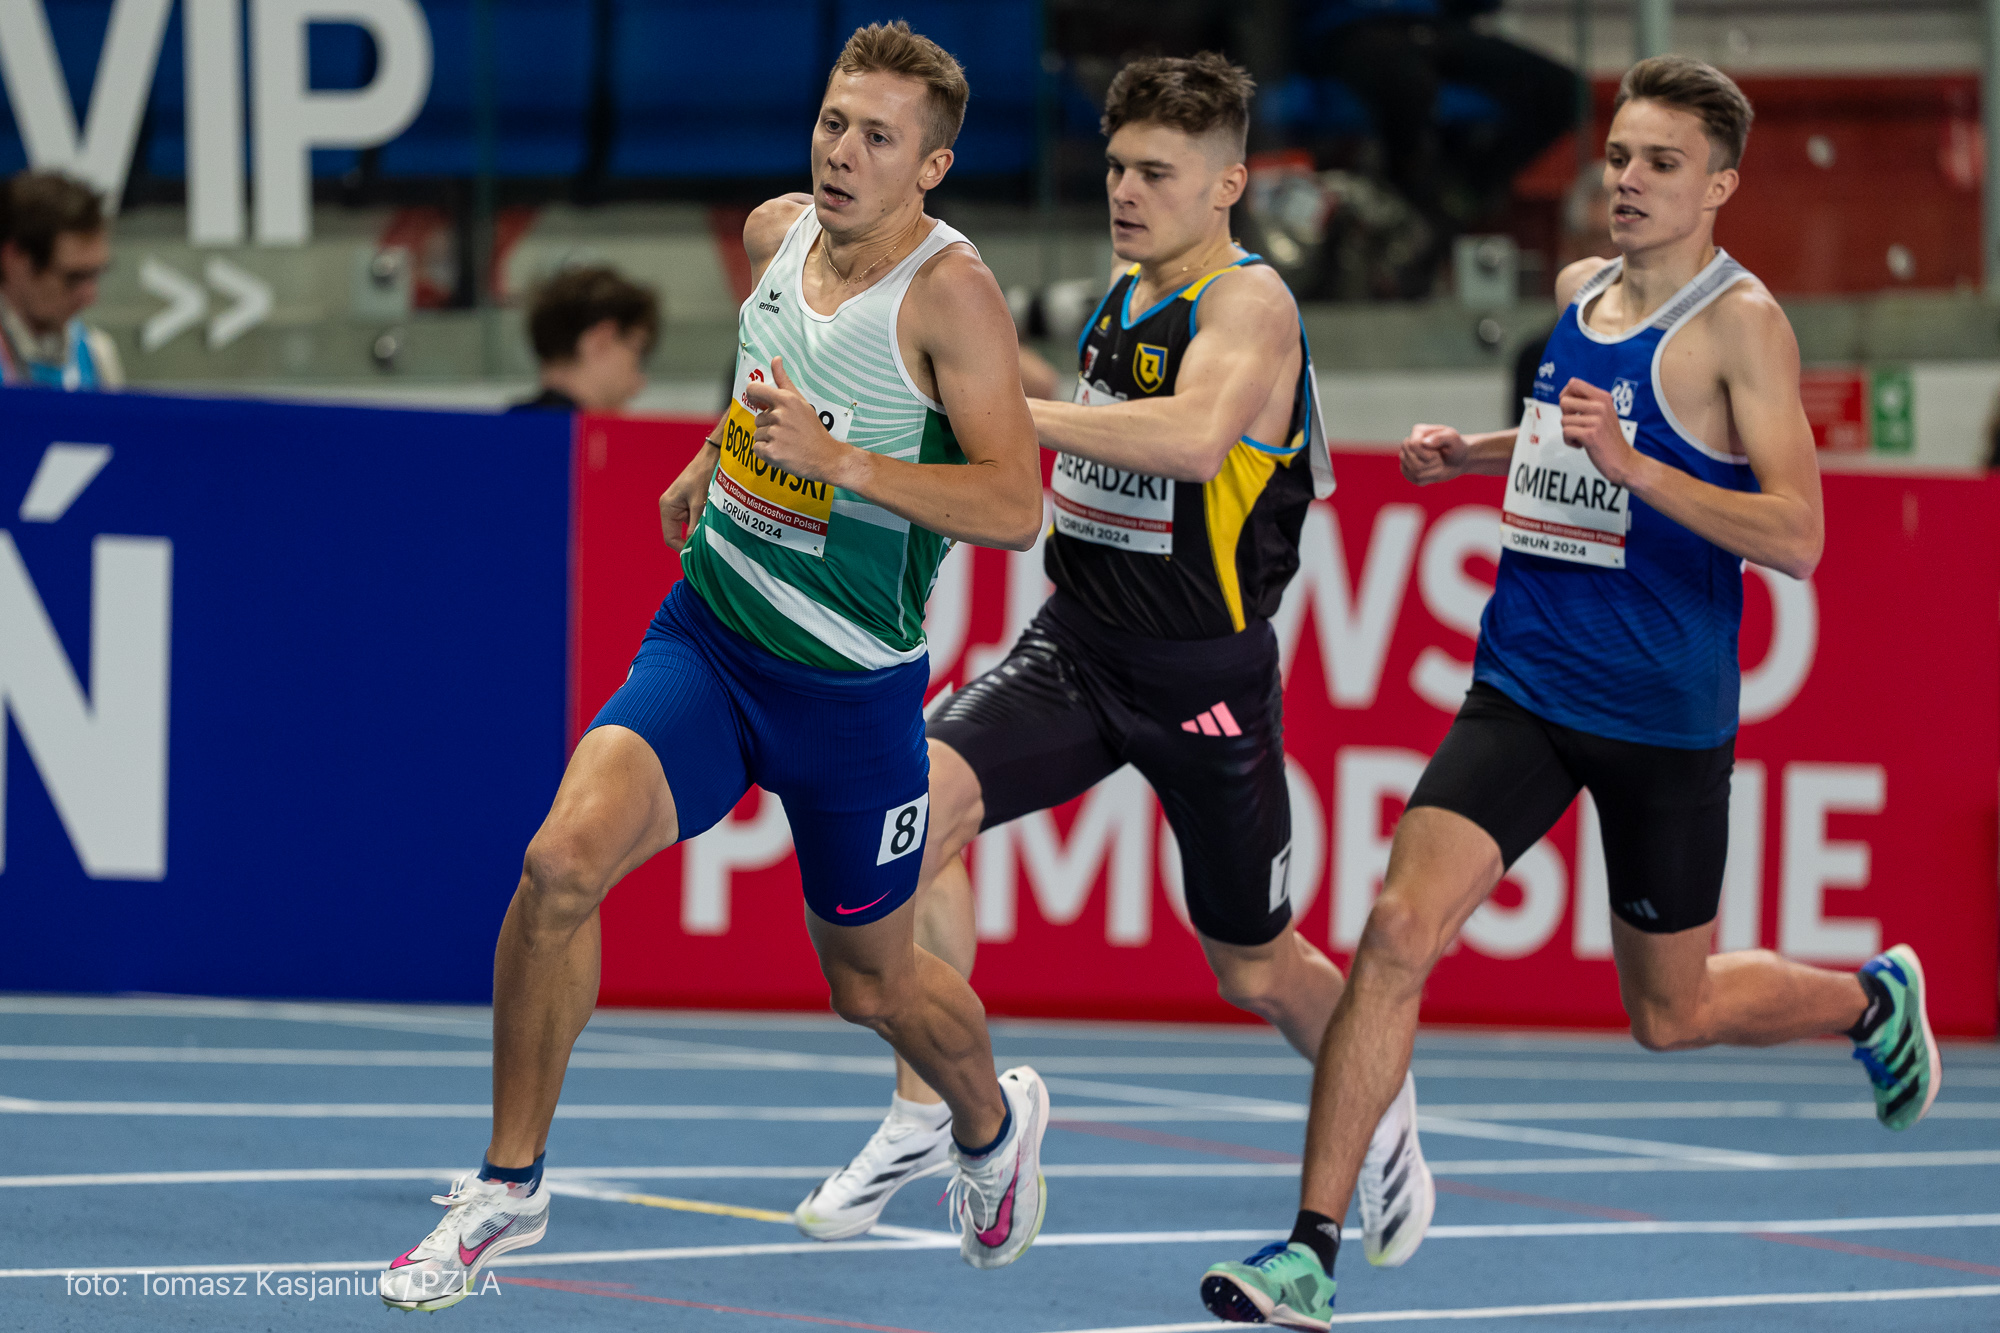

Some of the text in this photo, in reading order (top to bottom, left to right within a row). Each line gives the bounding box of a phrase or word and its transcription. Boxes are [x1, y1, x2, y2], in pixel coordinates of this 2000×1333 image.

[0, 0, 435, 247] VIP
[759, 302, 780, 314] erima
[723, 498, 782, 540] TORUŃ 2024
[746, 497, 792, 523] Mistrzostwa
[793, 517, 821, 532] Polski
[1097, 527, 1131, 545] 2024
[1552, 540, 1587, 557] 2024
[890, 805, 918, 855] 8
